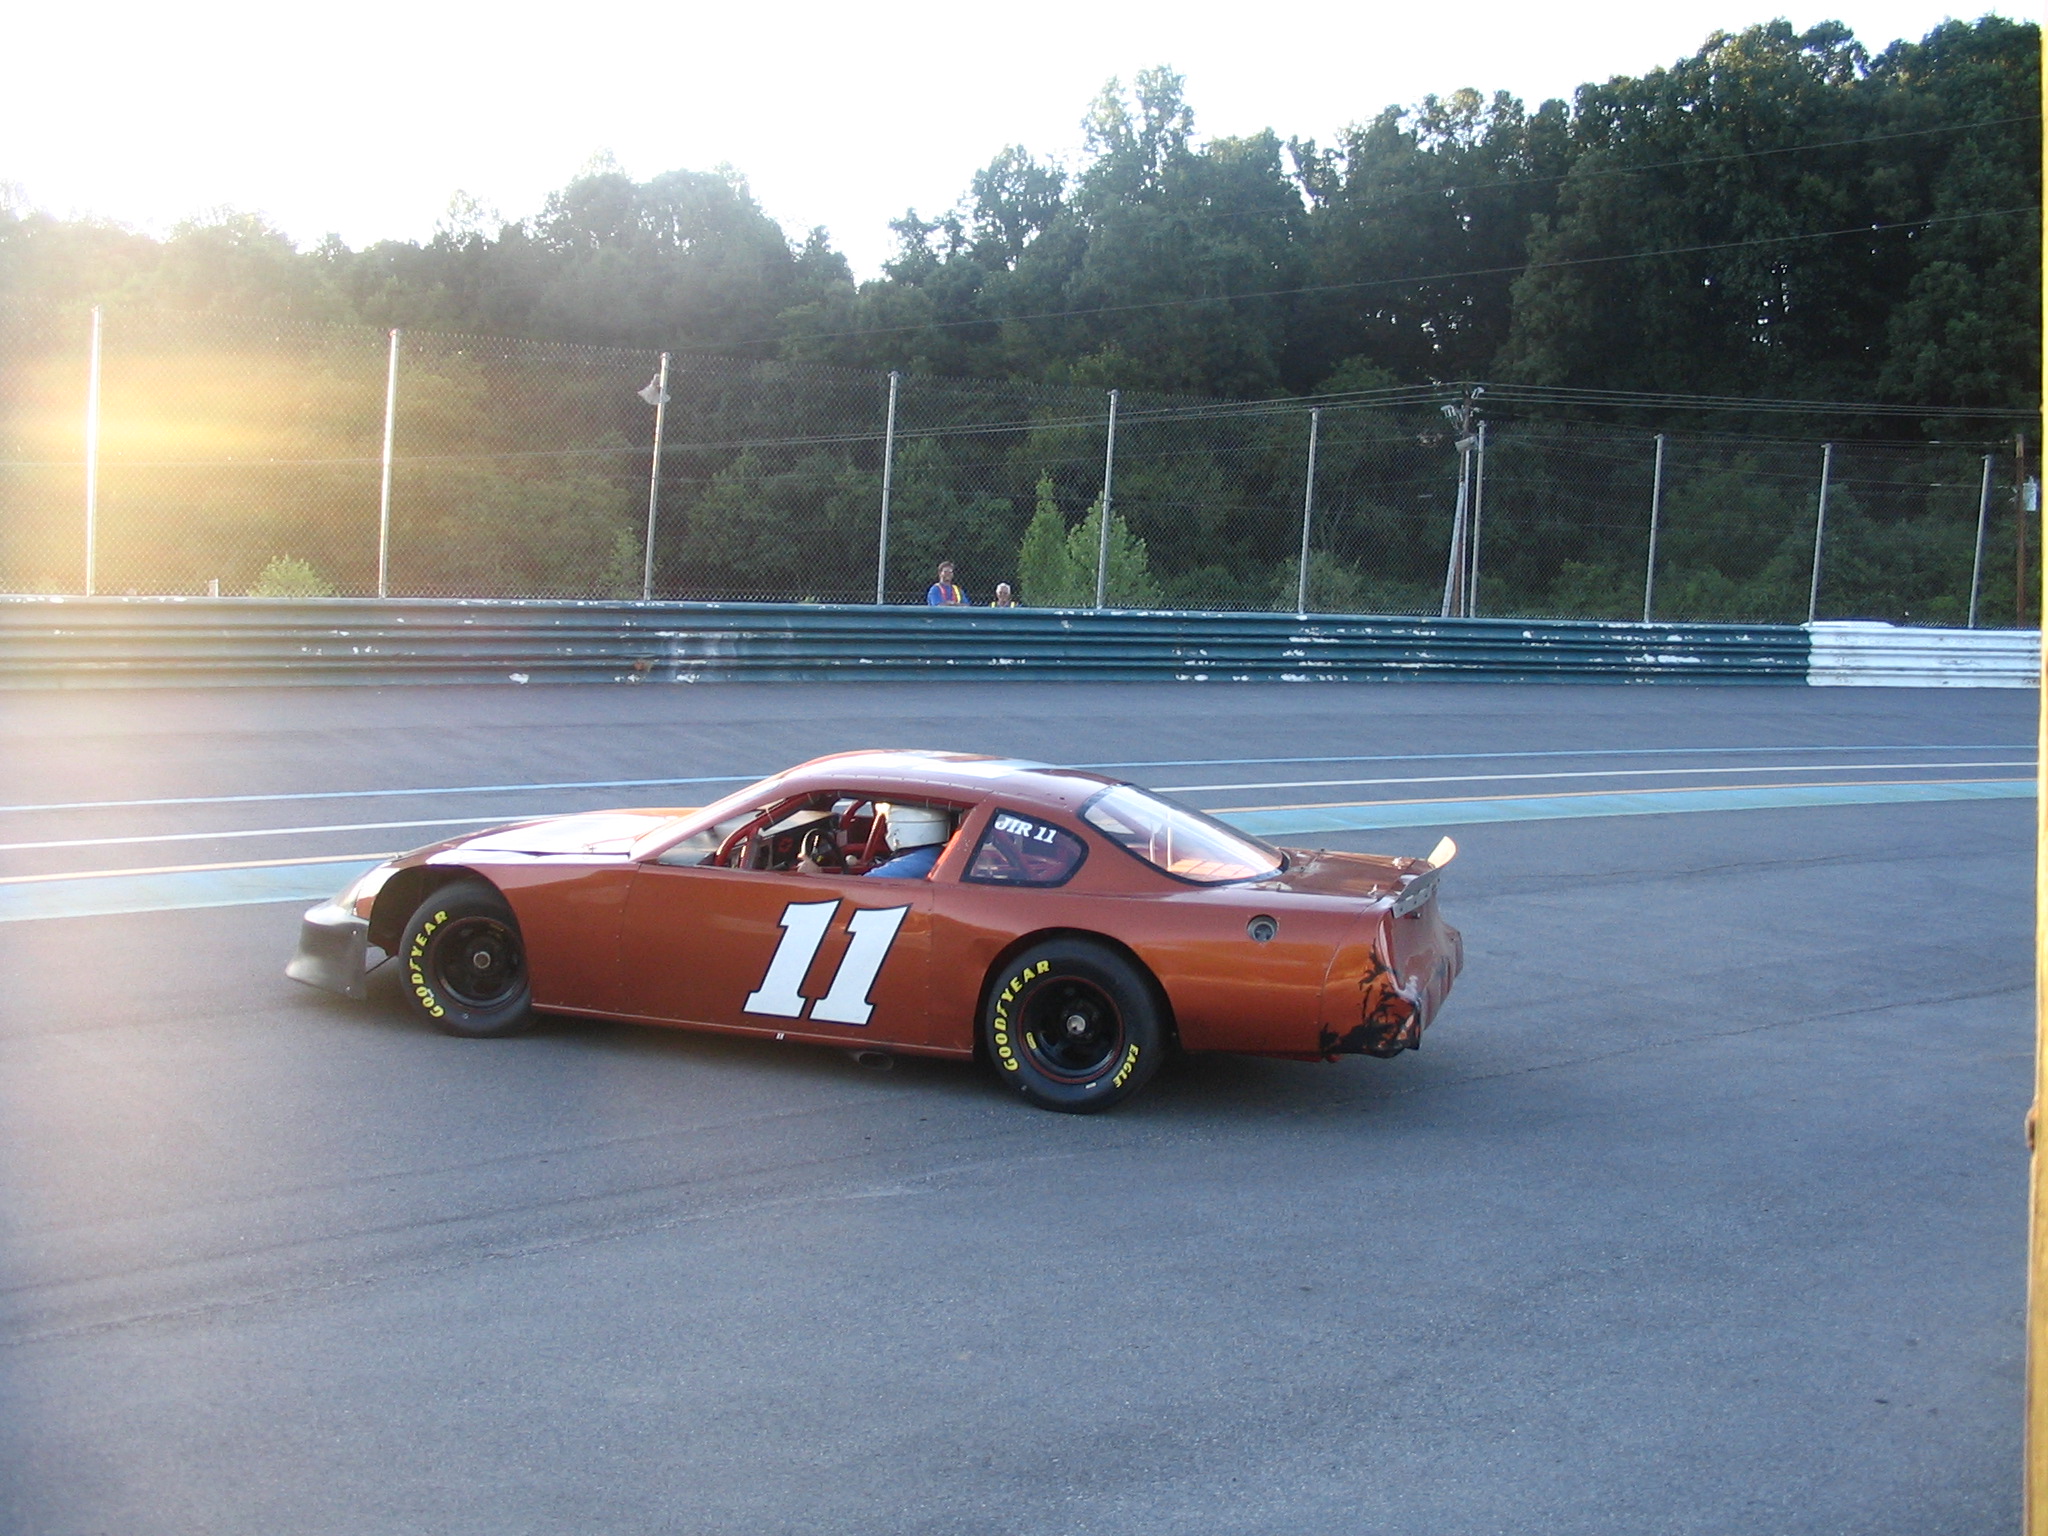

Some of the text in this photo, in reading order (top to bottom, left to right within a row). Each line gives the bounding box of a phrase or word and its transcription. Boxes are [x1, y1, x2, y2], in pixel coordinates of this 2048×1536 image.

[1034, 826, 1057, 844] 11
[409, 910, 448, 1017] GOODYEAR
[743, 898, 912, 1026] 11
[994, 959, 1050, 1071] GOODYEAR
[1112, 1043, 1139, 1088] EAGLE
